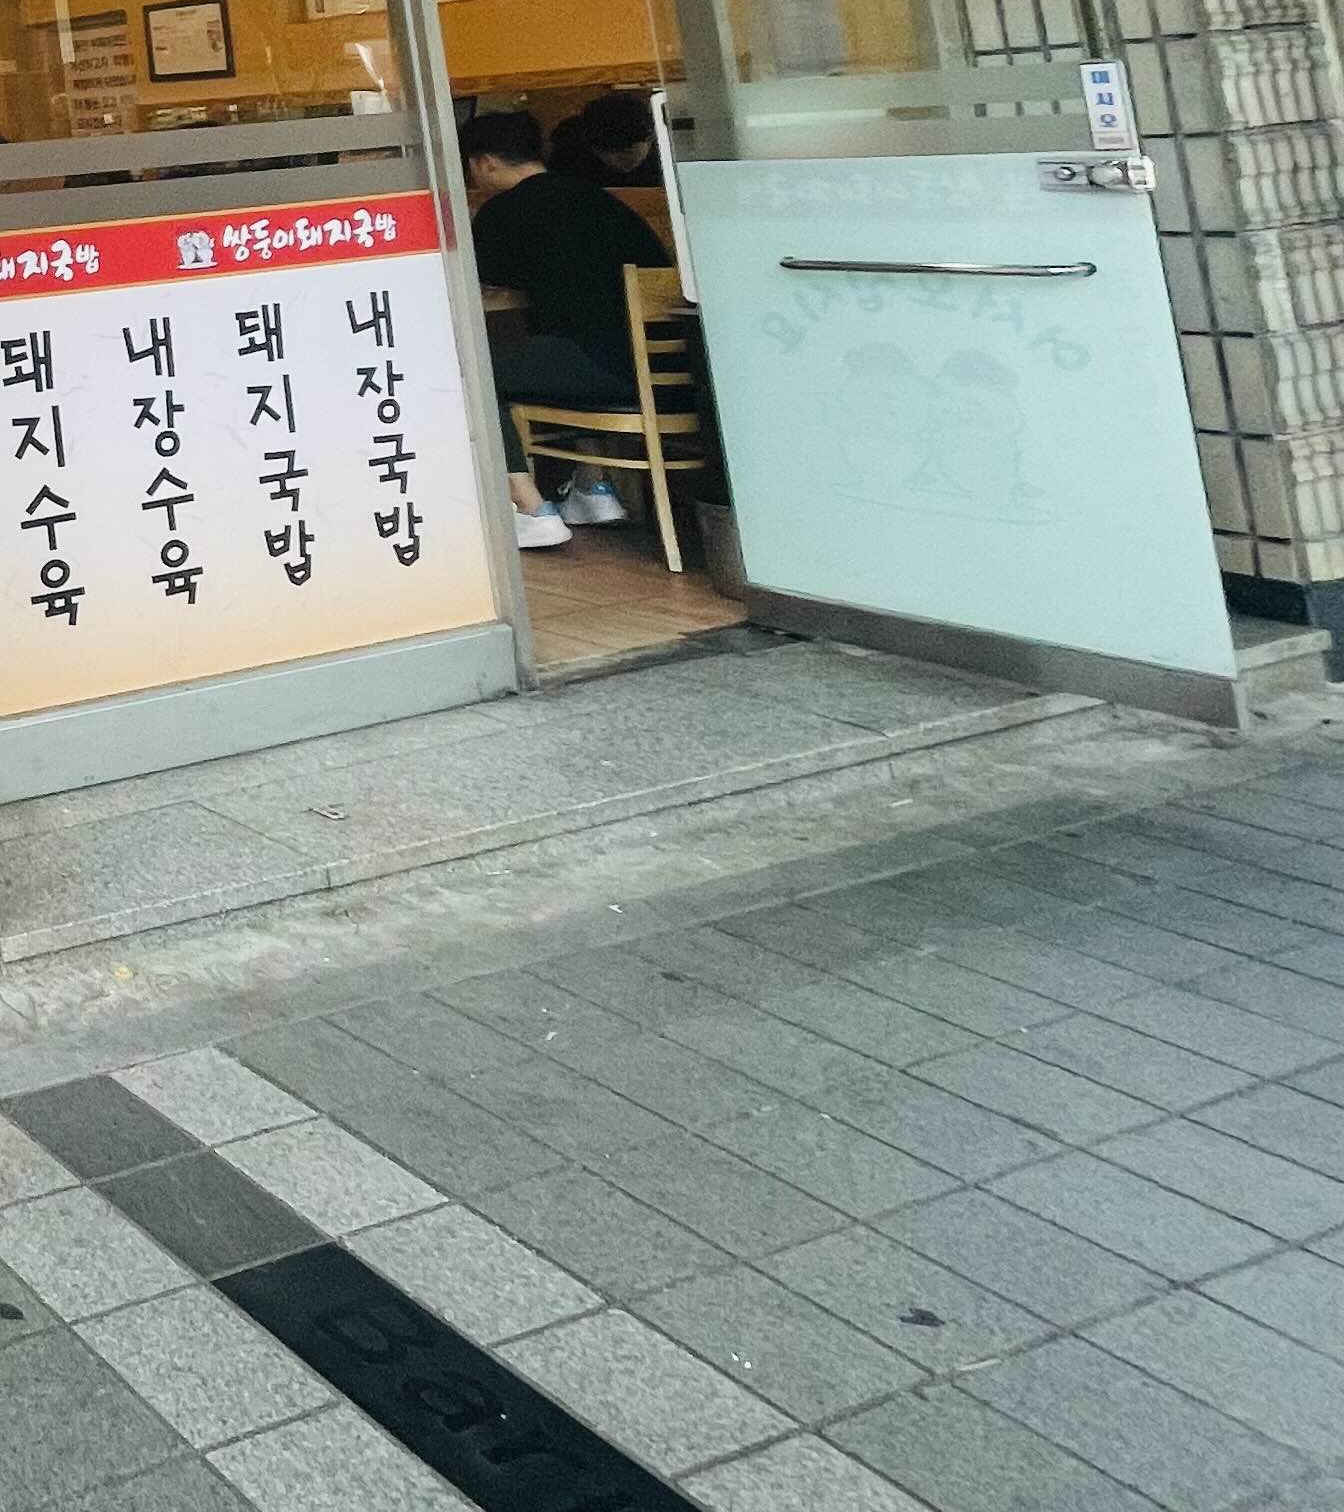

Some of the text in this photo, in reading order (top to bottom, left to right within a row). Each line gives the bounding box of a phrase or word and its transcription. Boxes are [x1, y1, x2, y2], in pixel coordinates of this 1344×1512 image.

[1, 331, 85, 625] 돼지수육
[123, 317, 203, 604] 내장수육
[236, 304, 314, 585] 돼지국밥
[346, 291, 422, 566] 내장국밥
